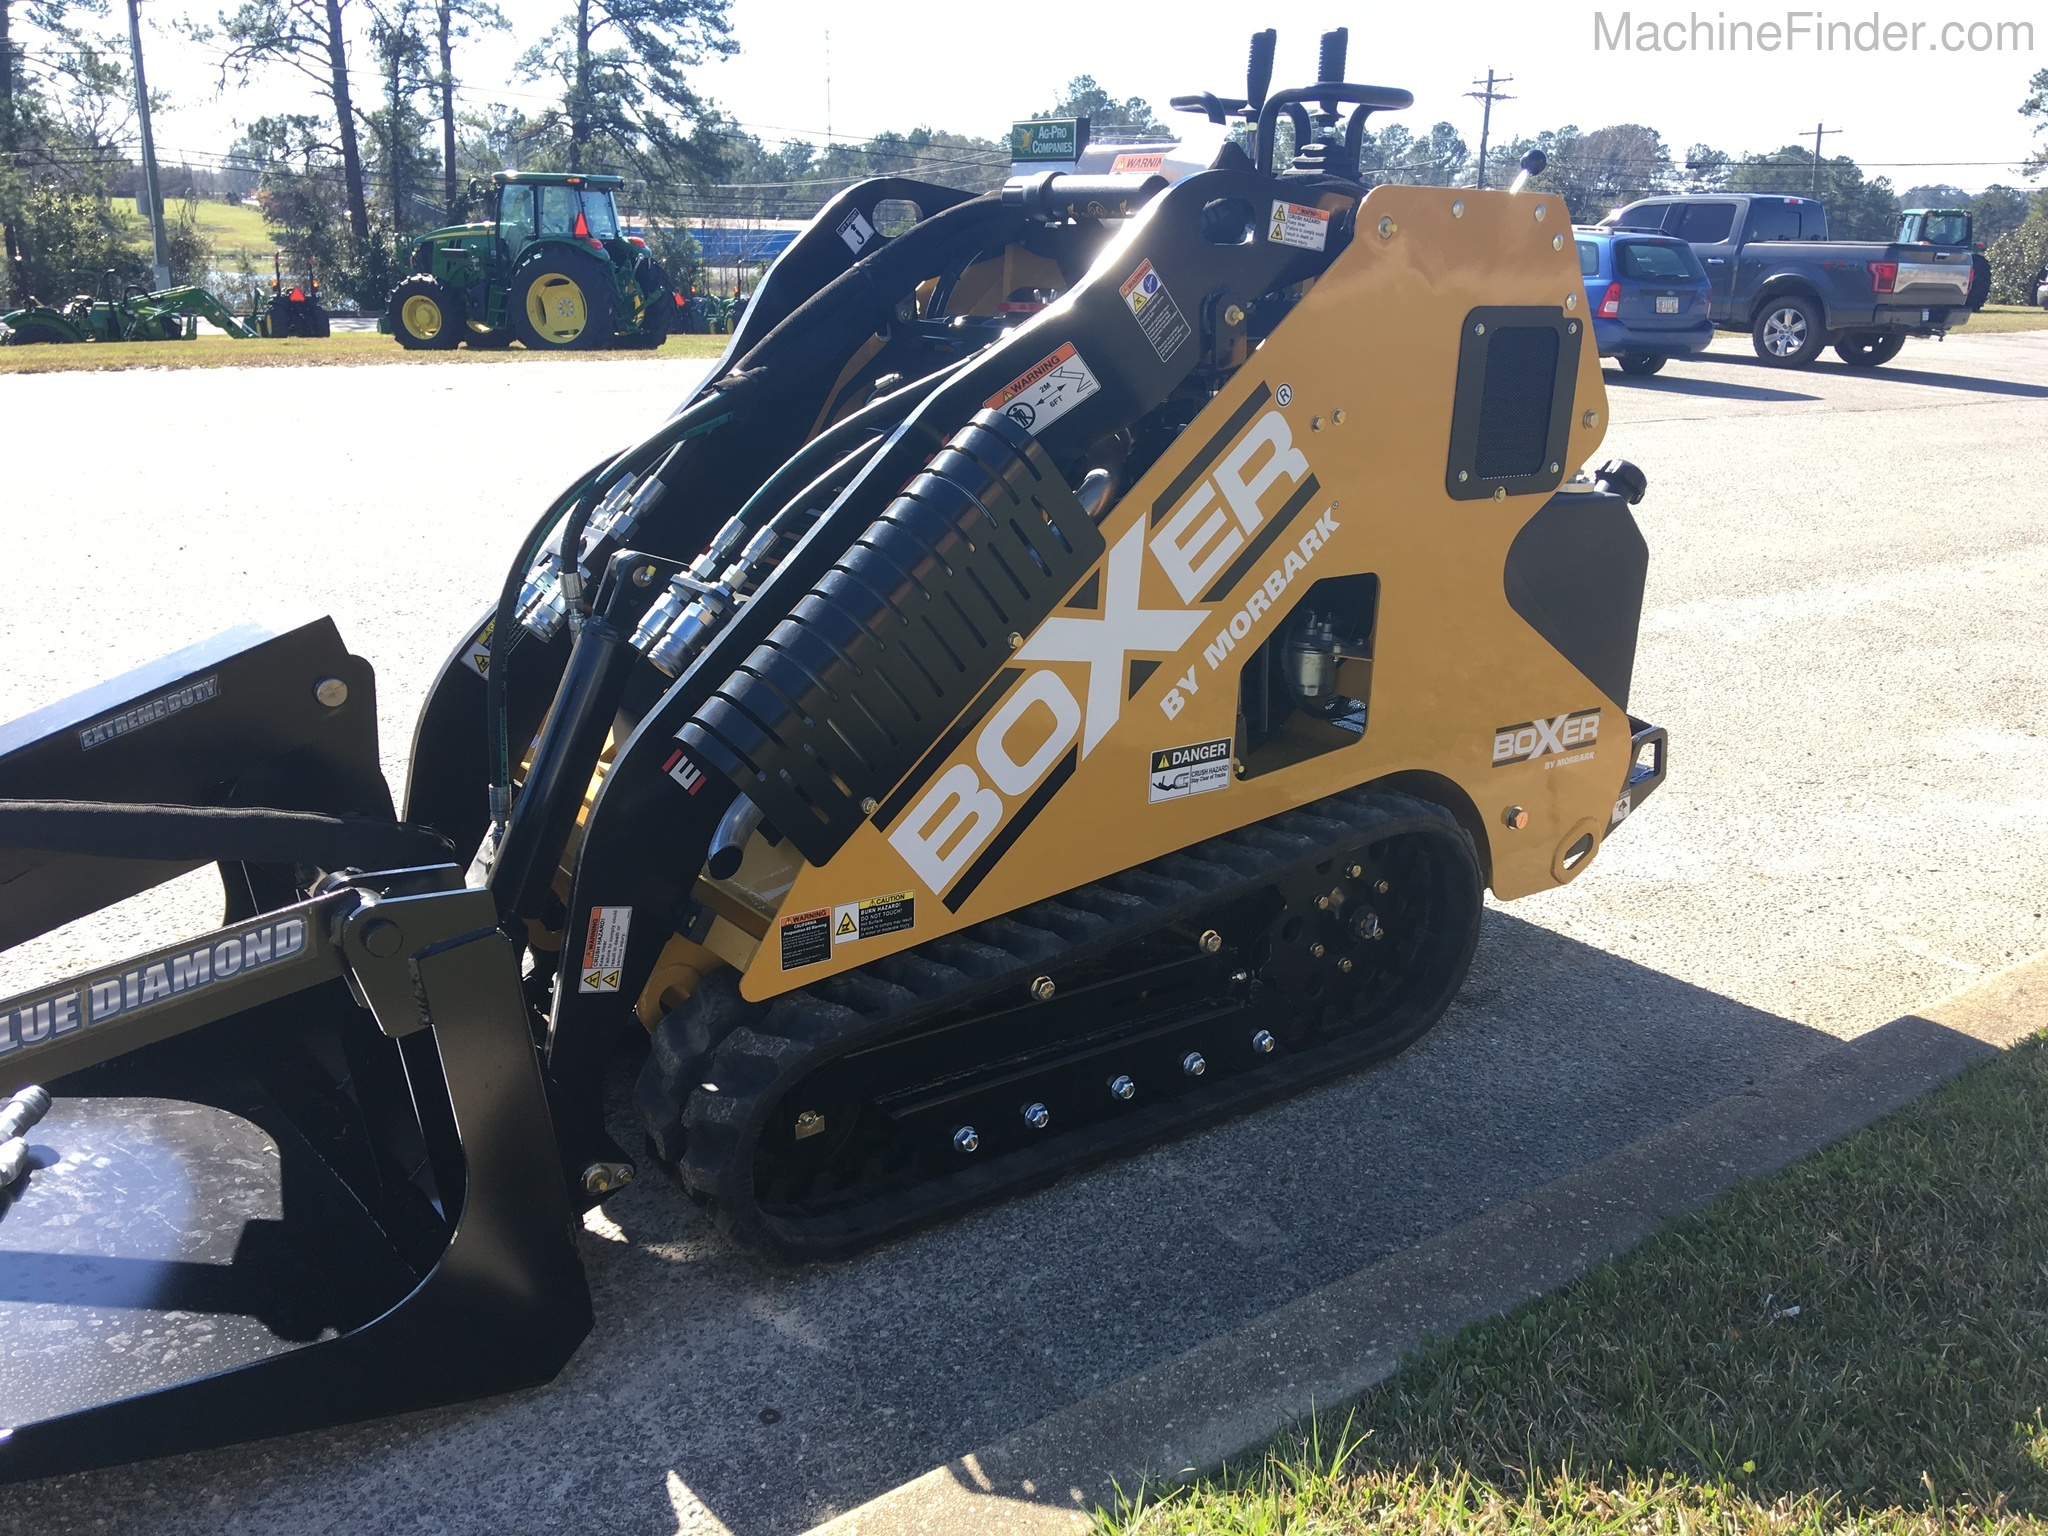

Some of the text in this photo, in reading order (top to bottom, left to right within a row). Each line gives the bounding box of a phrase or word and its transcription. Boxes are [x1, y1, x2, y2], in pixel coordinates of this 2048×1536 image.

[1032, 140, 1073, 154] COMPANIES
[1126, 157, 1162, 168] WARNIN
[1011, 356, 1060, 393] WARNING
[1039, 382, 1051, 394] 2M
[1050, 395, 1063, 408] 6FT
[1159, 508, 1340, 720] BY MORBARK
[887, 410, 1310, 896] BOXER
[82, 678, 214, 748] EXTREME DUTY
[1493, 713, 1600, 760] BOXER
[1172, 742, 1226, 765] DANGER
[1544, 751, 1595, 770] BY MORBARK
[1192, 765, 1228, 777] CRUSH HAZARD
[877, 894, 904, 904] CAUTION
[878, 902, 901, 912] HAZARD!
[793, 910, 826, 922] WARNING
[884, 908, 902, 916] TOUCH!
[588, 919, 598, 950] WARNING
[597, 919, 605, 945] HAZARD!
[0, 919, 302, 1052] LUE DIAMOND
